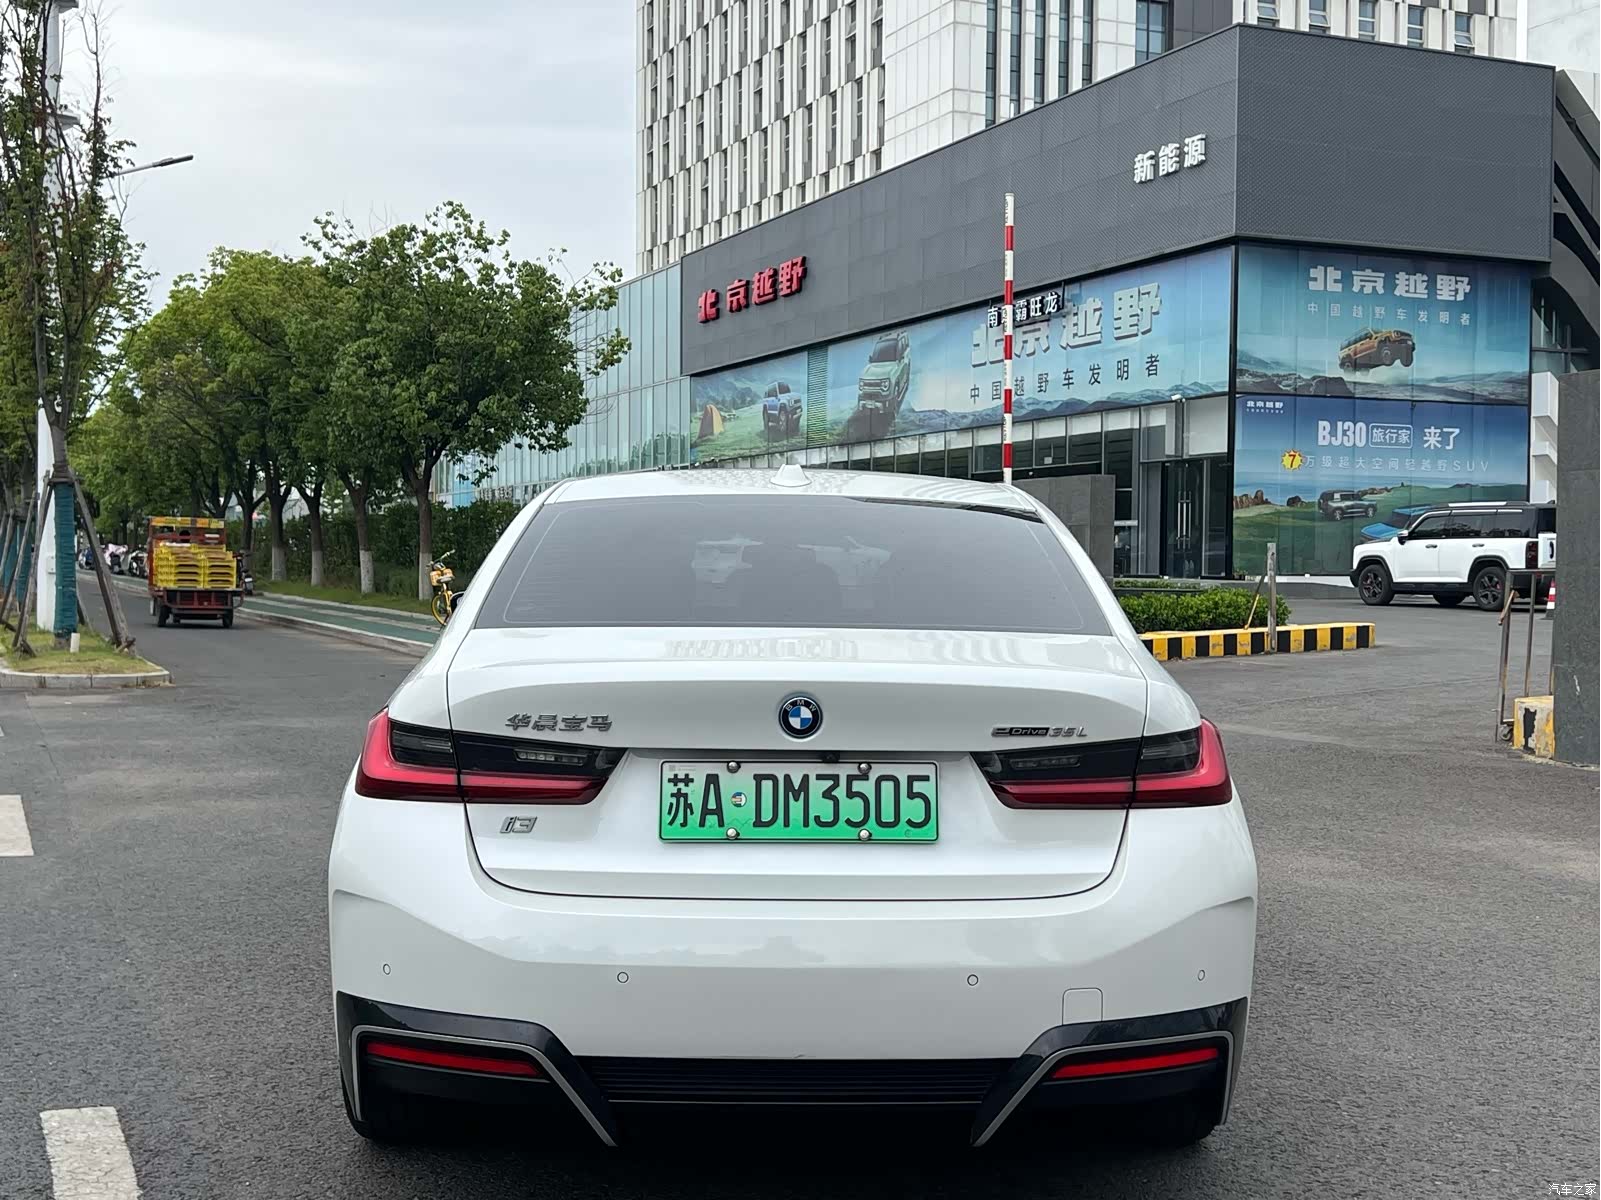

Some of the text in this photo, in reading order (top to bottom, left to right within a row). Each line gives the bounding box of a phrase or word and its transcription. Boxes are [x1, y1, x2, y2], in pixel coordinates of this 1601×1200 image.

[1133, 133, 1206, 184] 新能源
[697, 256, 806, 323] 北京越野
[1308, 265, 1471, 301] 北京越野
[1307, 302, 1471, 326] 中国越野车发明者
[970, 353, 1160, 404] 中国越野车发明者
[1317, 420, 1460, 450] BJ30 旅行家 来了
[785, 699, 817, 712] BMW
[504, 712, 613, 732] 华晨宝马
[500, 815, 538, 834] i3
